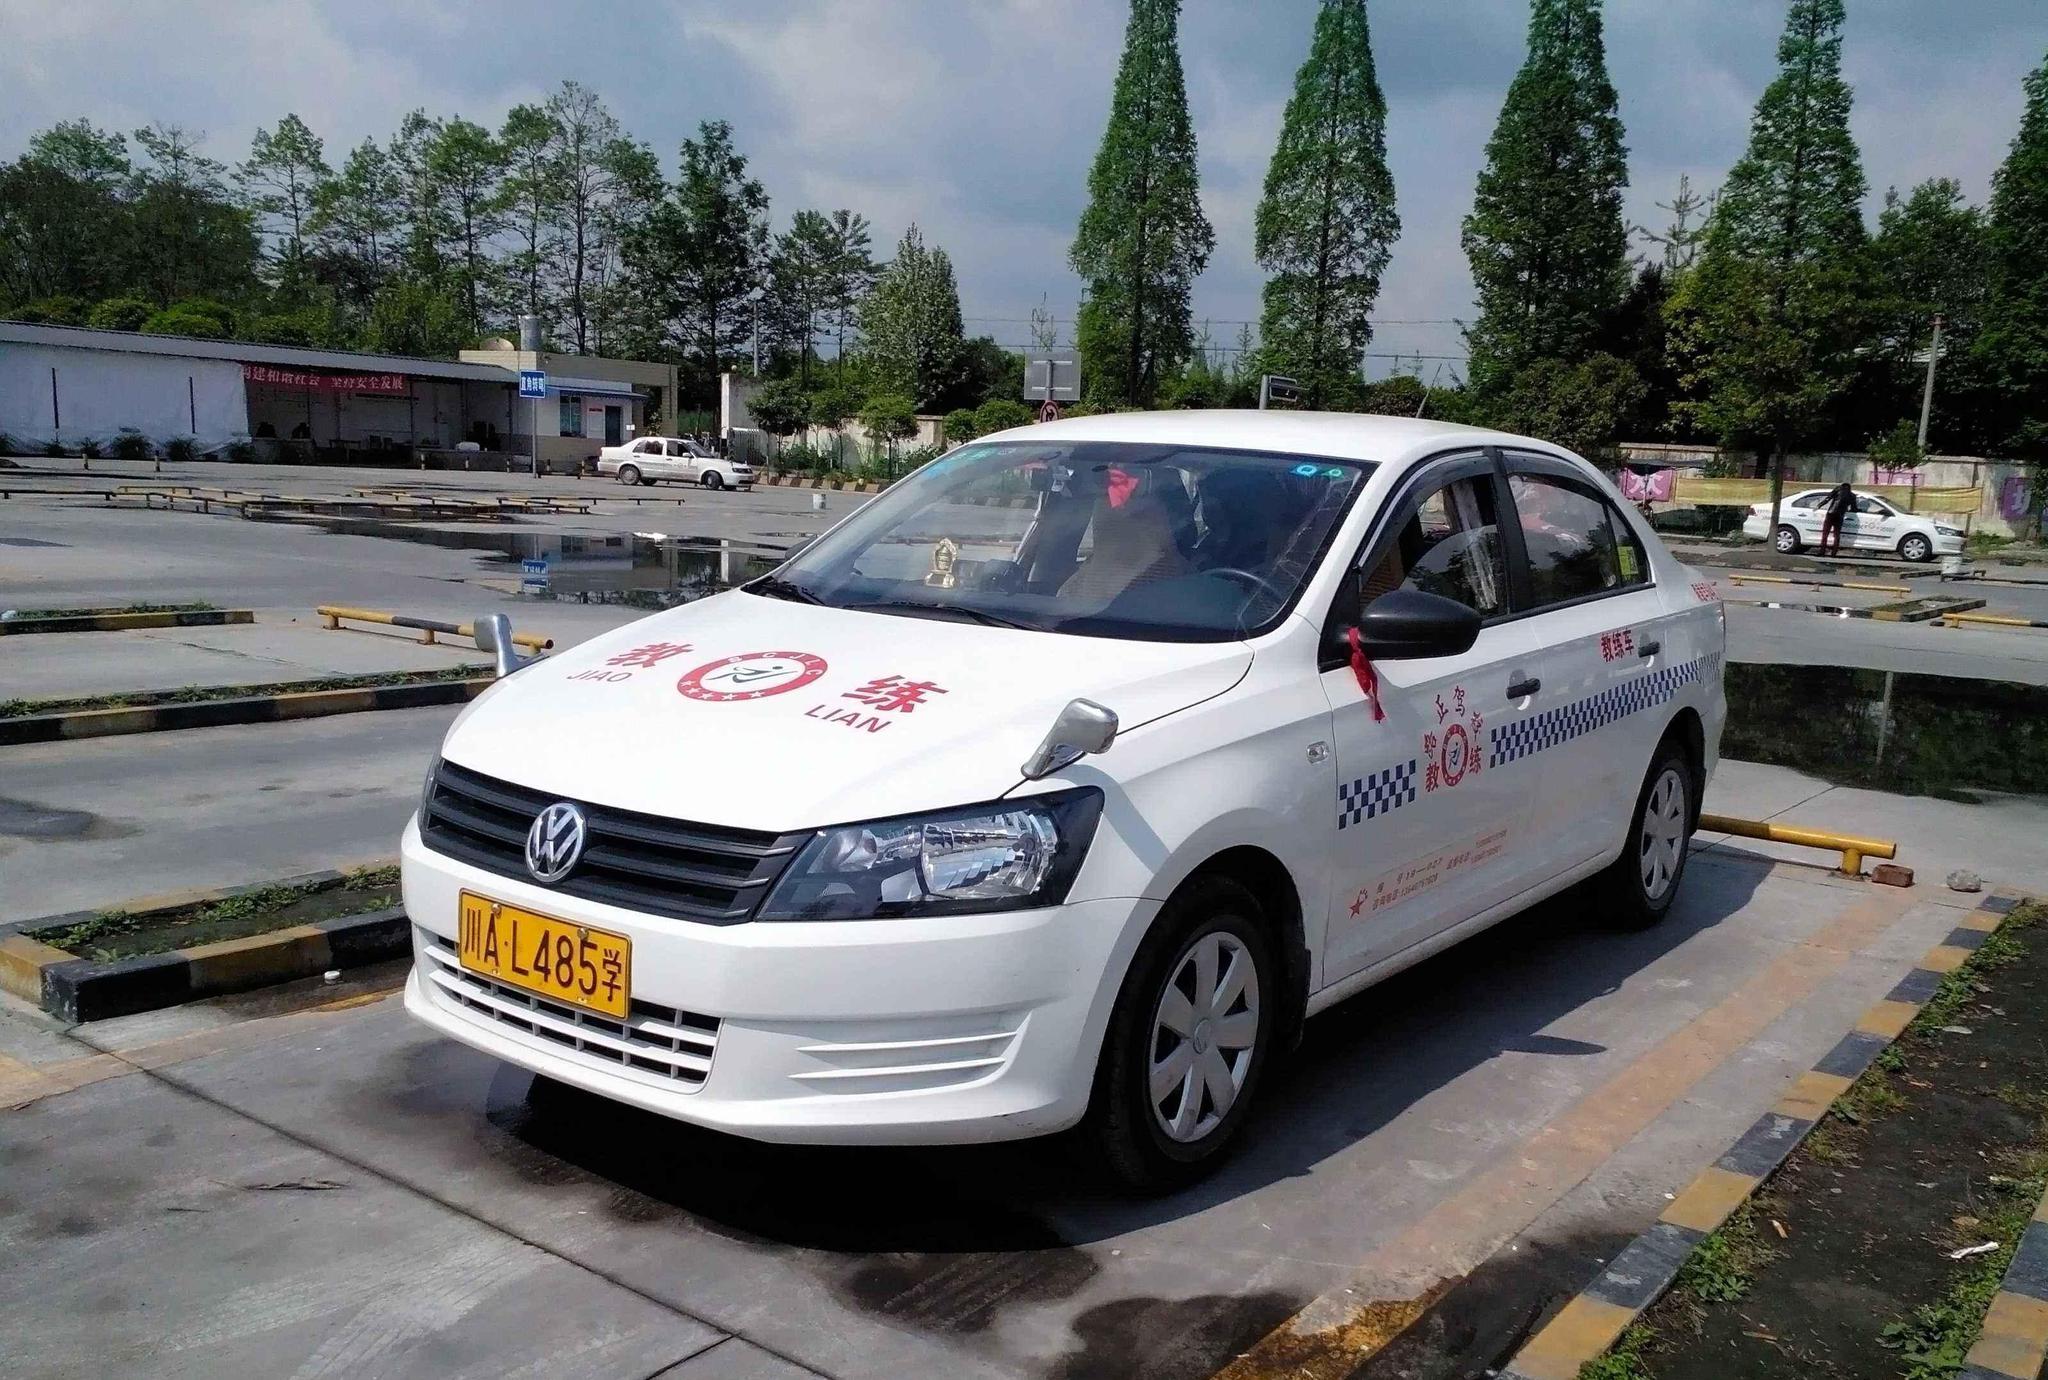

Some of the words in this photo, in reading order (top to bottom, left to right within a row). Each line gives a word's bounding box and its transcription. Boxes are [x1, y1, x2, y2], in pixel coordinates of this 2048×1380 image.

[1600, 627, 1634, 663] 教练车
[566, 669, 632, 683] JIAO
[841, 674, 949, 713] 练
[804, 704, 893, 733] LIAN
